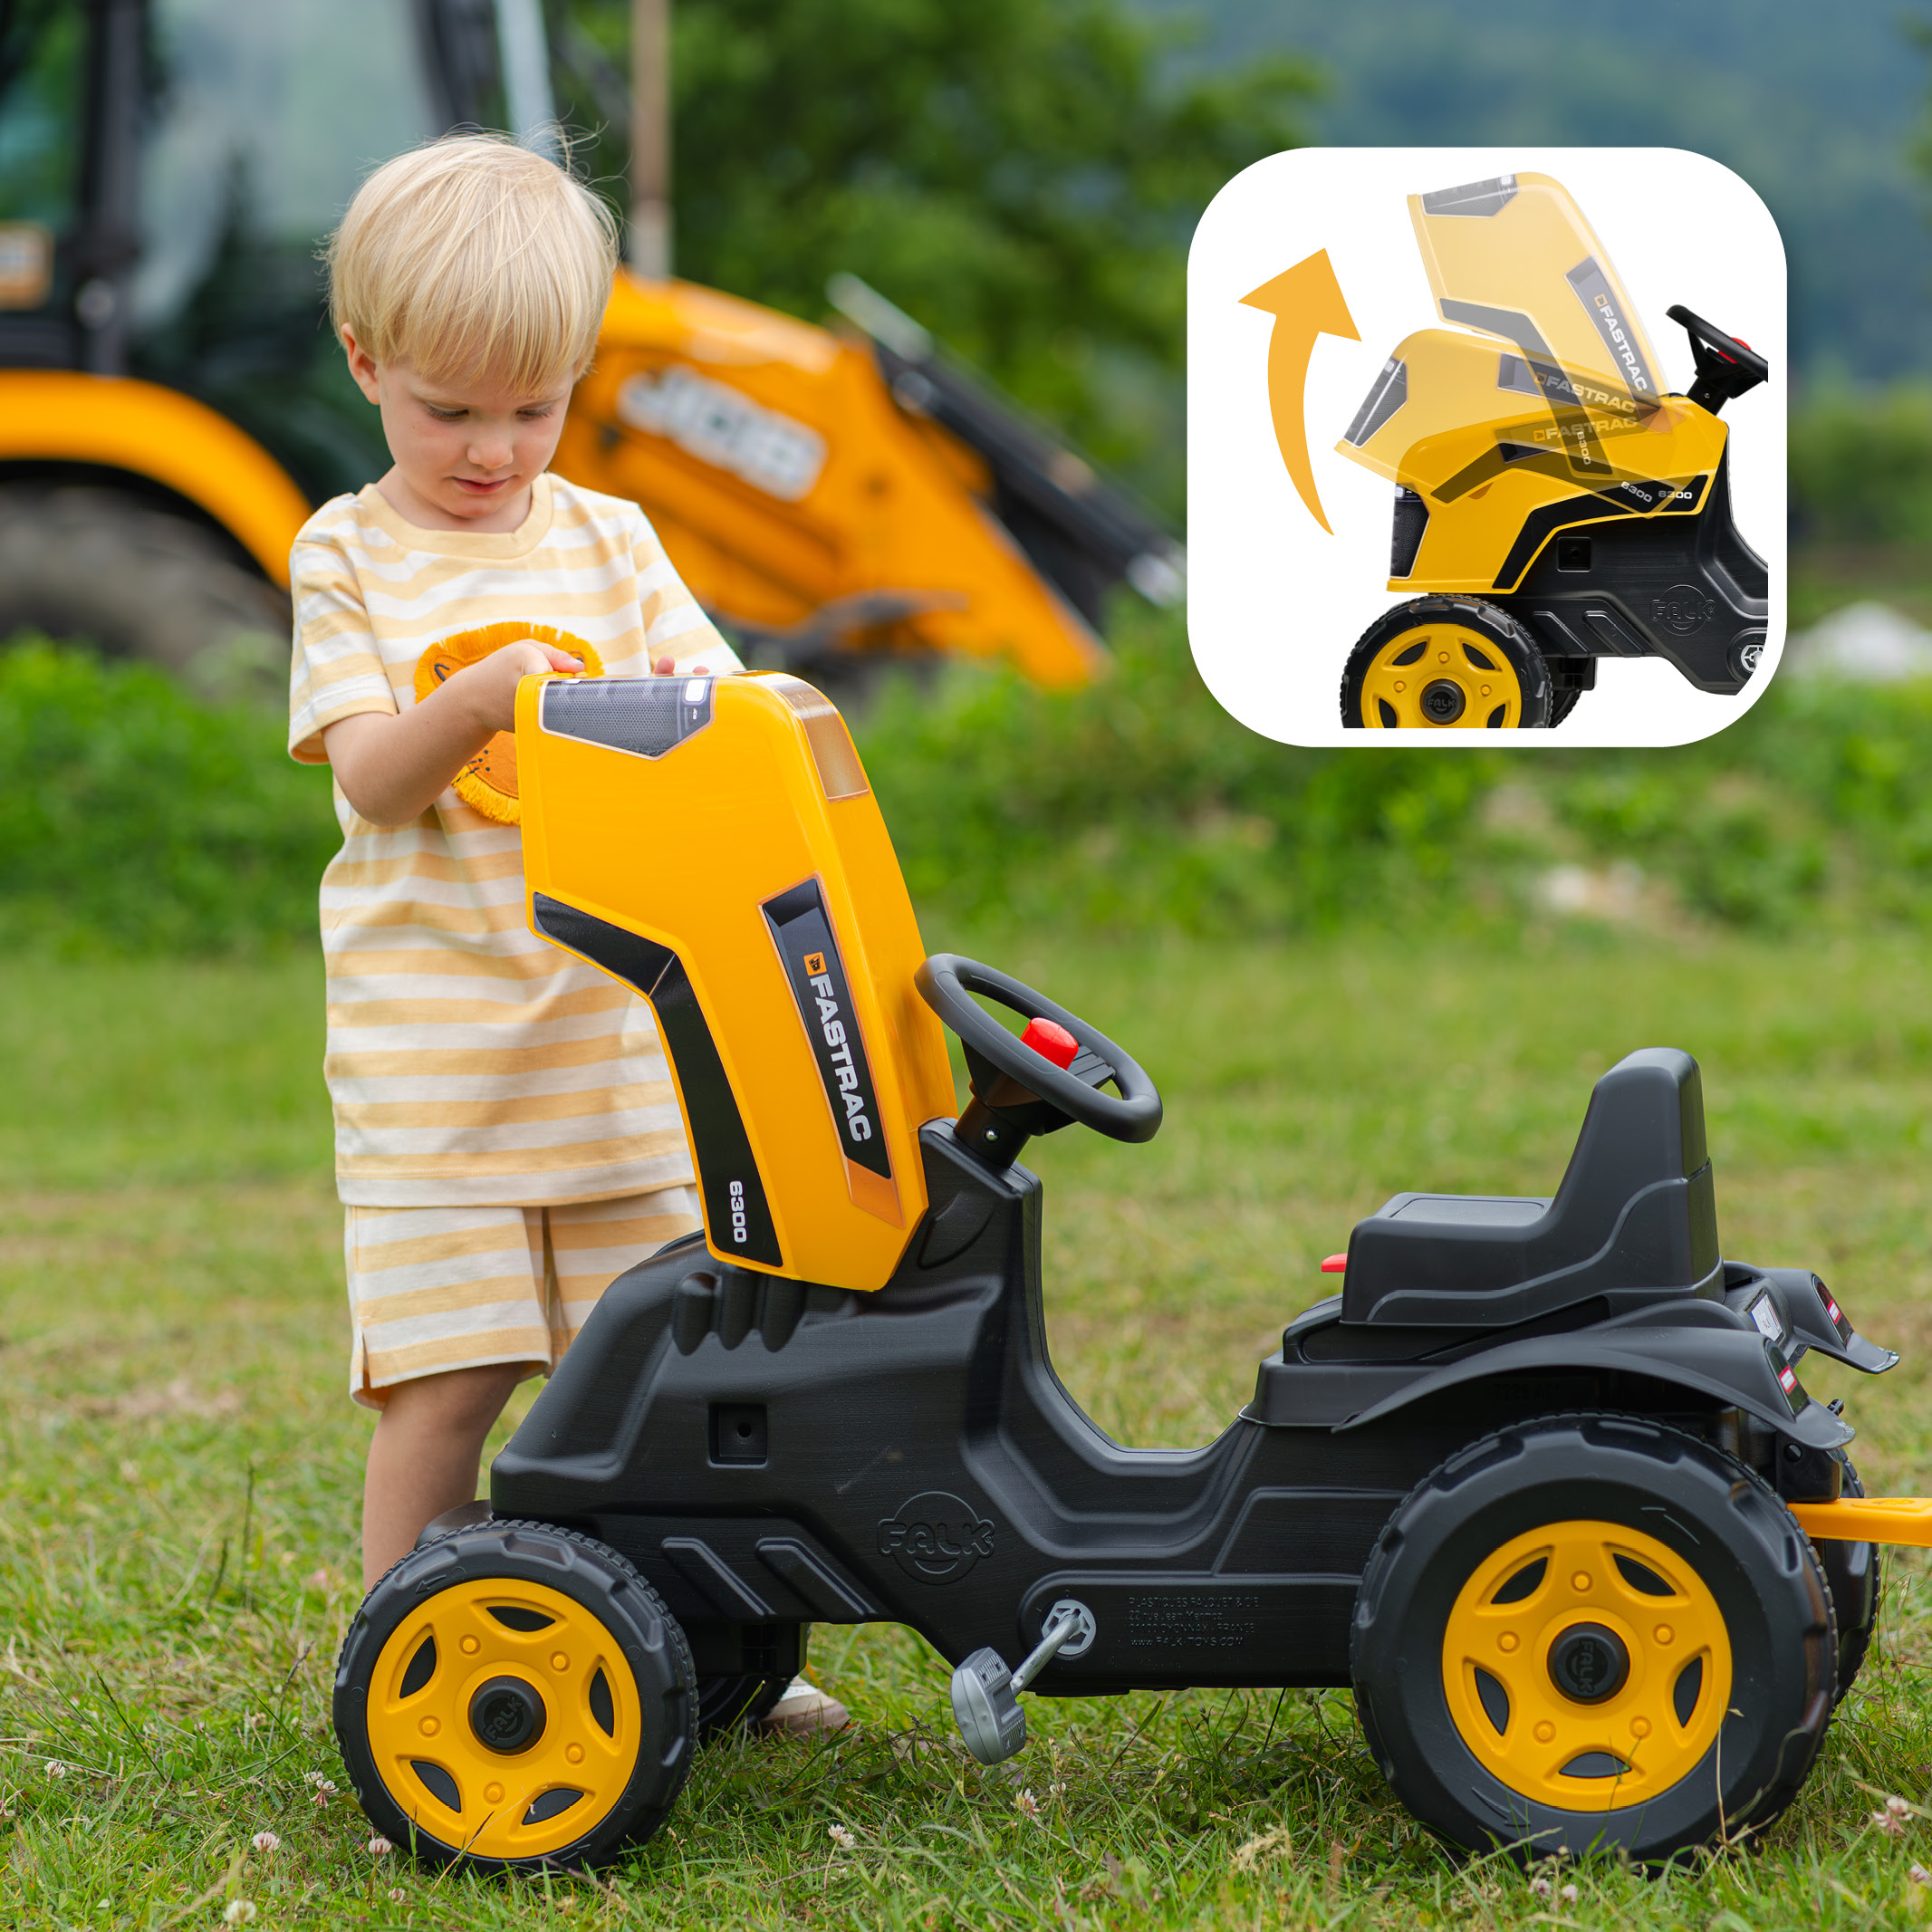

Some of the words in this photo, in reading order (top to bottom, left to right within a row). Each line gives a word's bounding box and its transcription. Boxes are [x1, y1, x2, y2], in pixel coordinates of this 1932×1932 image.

[1600, 304, 1648, 392] FASTRAC
[1546, 375, 1636, 413] FASTRAC
[1576, 431, 1591, 465] 6300
[1620, 481, 1653, 503] 6300
[1658, 490, 1693, 499] 6300
[1651, 600, 1714, 620] FALK
[1427, 697, 1456, 707] FALK
[810, 974, 871, 1142] FASTRAC
[729, 1180, 747, 1244] 6300
[879, 1521, 994, 1556] FALK
[1579, 1639, 1595, 1693] FALK
[484, 1696, 523, 1740] FALK
